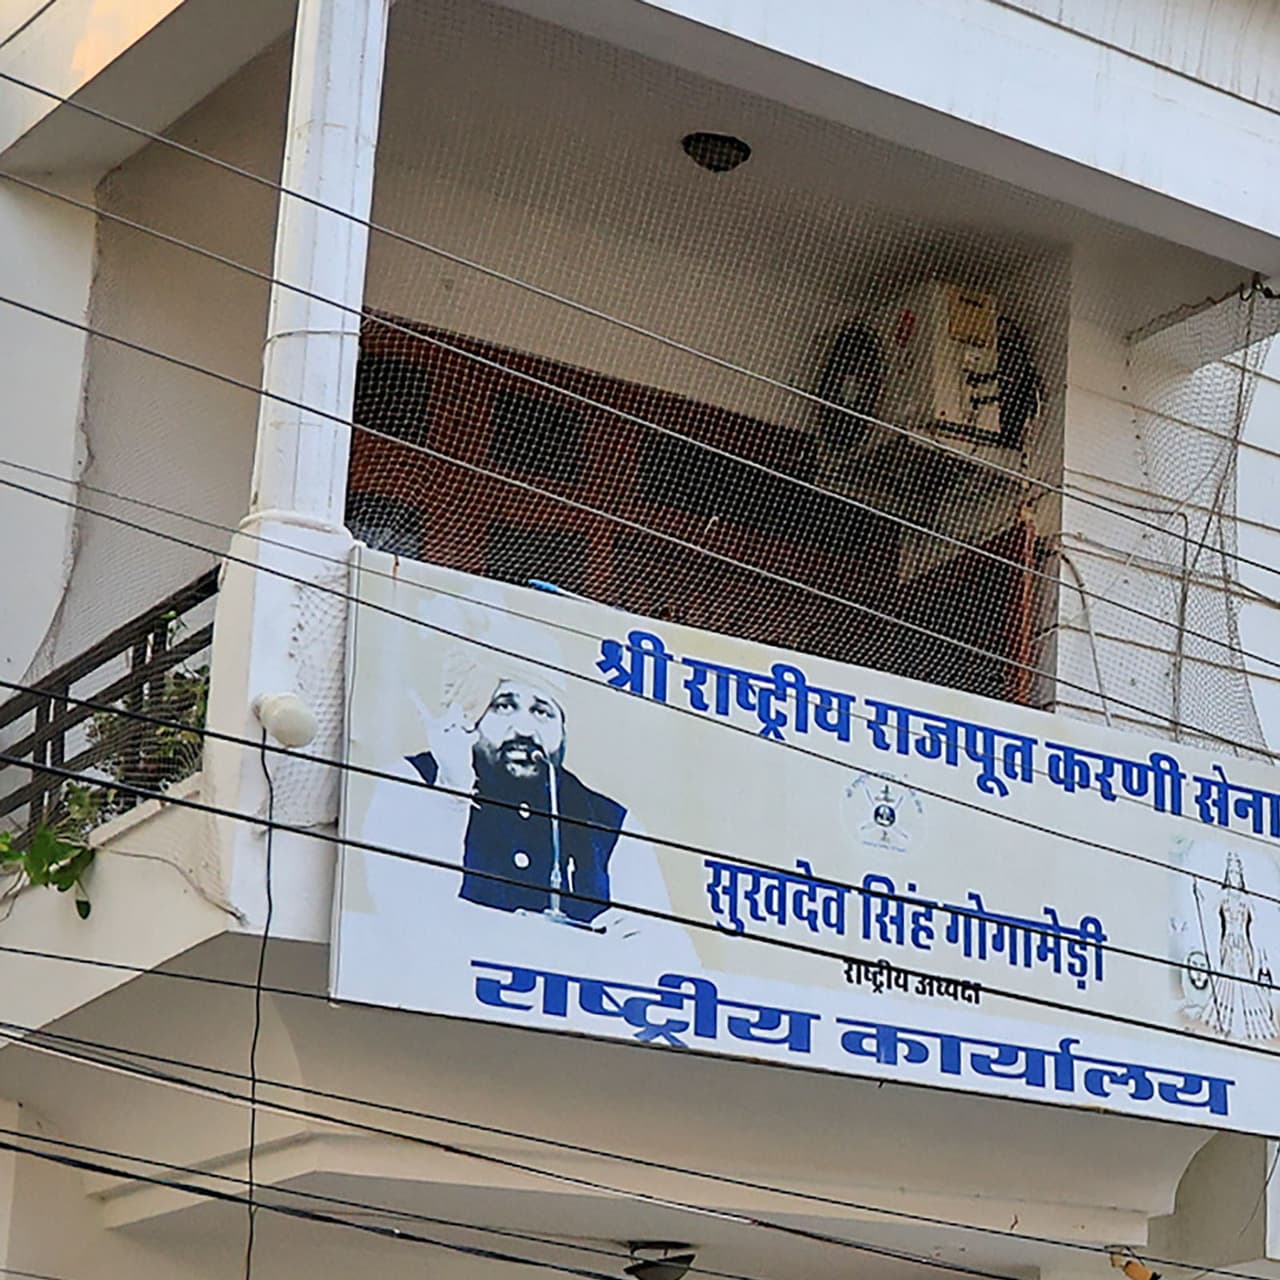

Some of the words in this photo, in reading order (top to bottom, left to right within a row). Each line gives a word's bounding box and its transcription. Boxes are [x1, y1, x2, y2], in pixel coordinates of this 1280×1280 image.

[596, 630, 674, 704] श्री
[682, 657, 856, 742] राष्ट्रीय
[865, 699, 1037, 798] राजपूत
[1045, 740, 1186, 816] करणी
[704, 859, 852, 936] सुखदेव
[859, 873, 939, 950] सिंह
[943, 892, 1108, 990] गोगामेड़ी
[843, 958, 911, 995] राष्ट्रीय
[915, 972, 982, 1004] अध्यक्ष
[470, 960, 822, 1053] राष्ट्रीय
[836, 1017, 1236, 1116] कार्यालय
